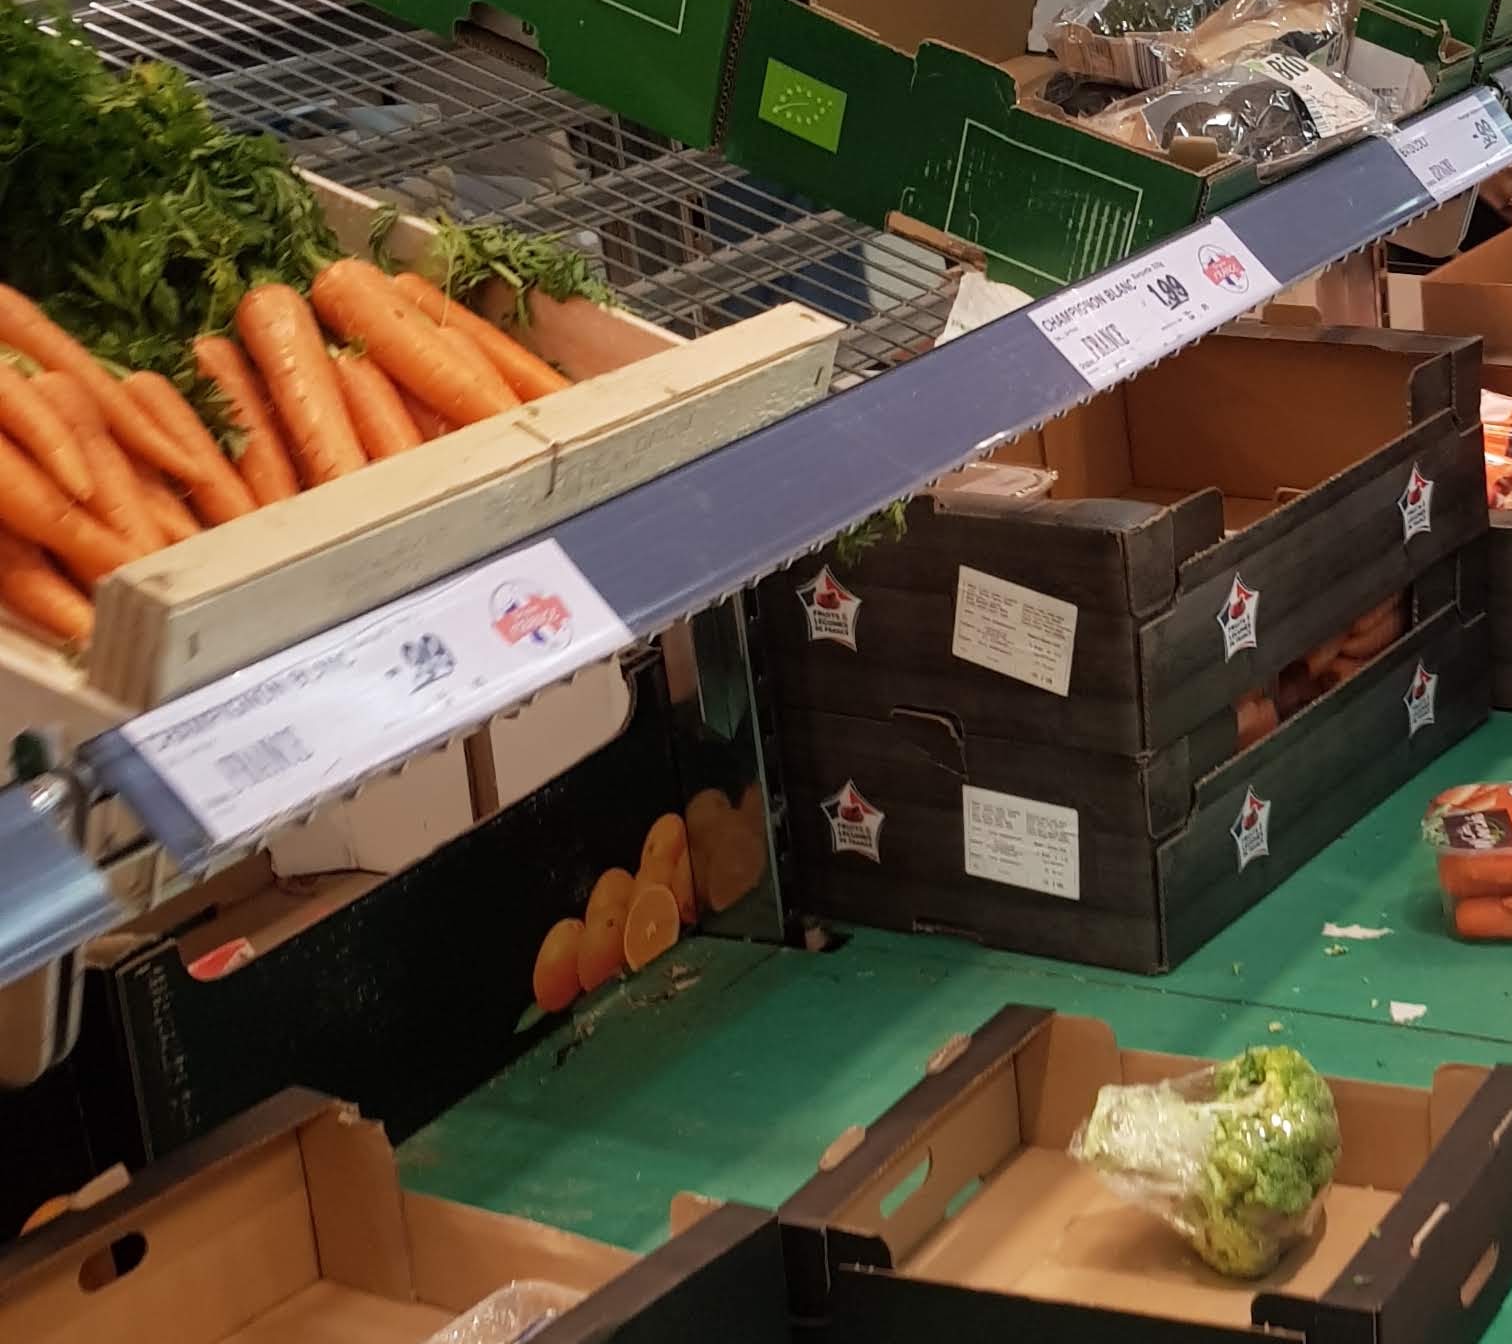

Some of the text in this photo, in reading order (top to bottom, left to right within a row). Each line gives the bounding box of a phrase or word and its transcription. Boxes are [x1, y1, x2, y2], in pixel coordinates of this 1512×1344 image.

[1041, 287, 1107, 333] CHAMPIGNON
[1103, 277, 1137, 304] BLANC
[1146, 274, 1189, 308] 1.99
[1080, 323, 1130, 361] FRANCE
